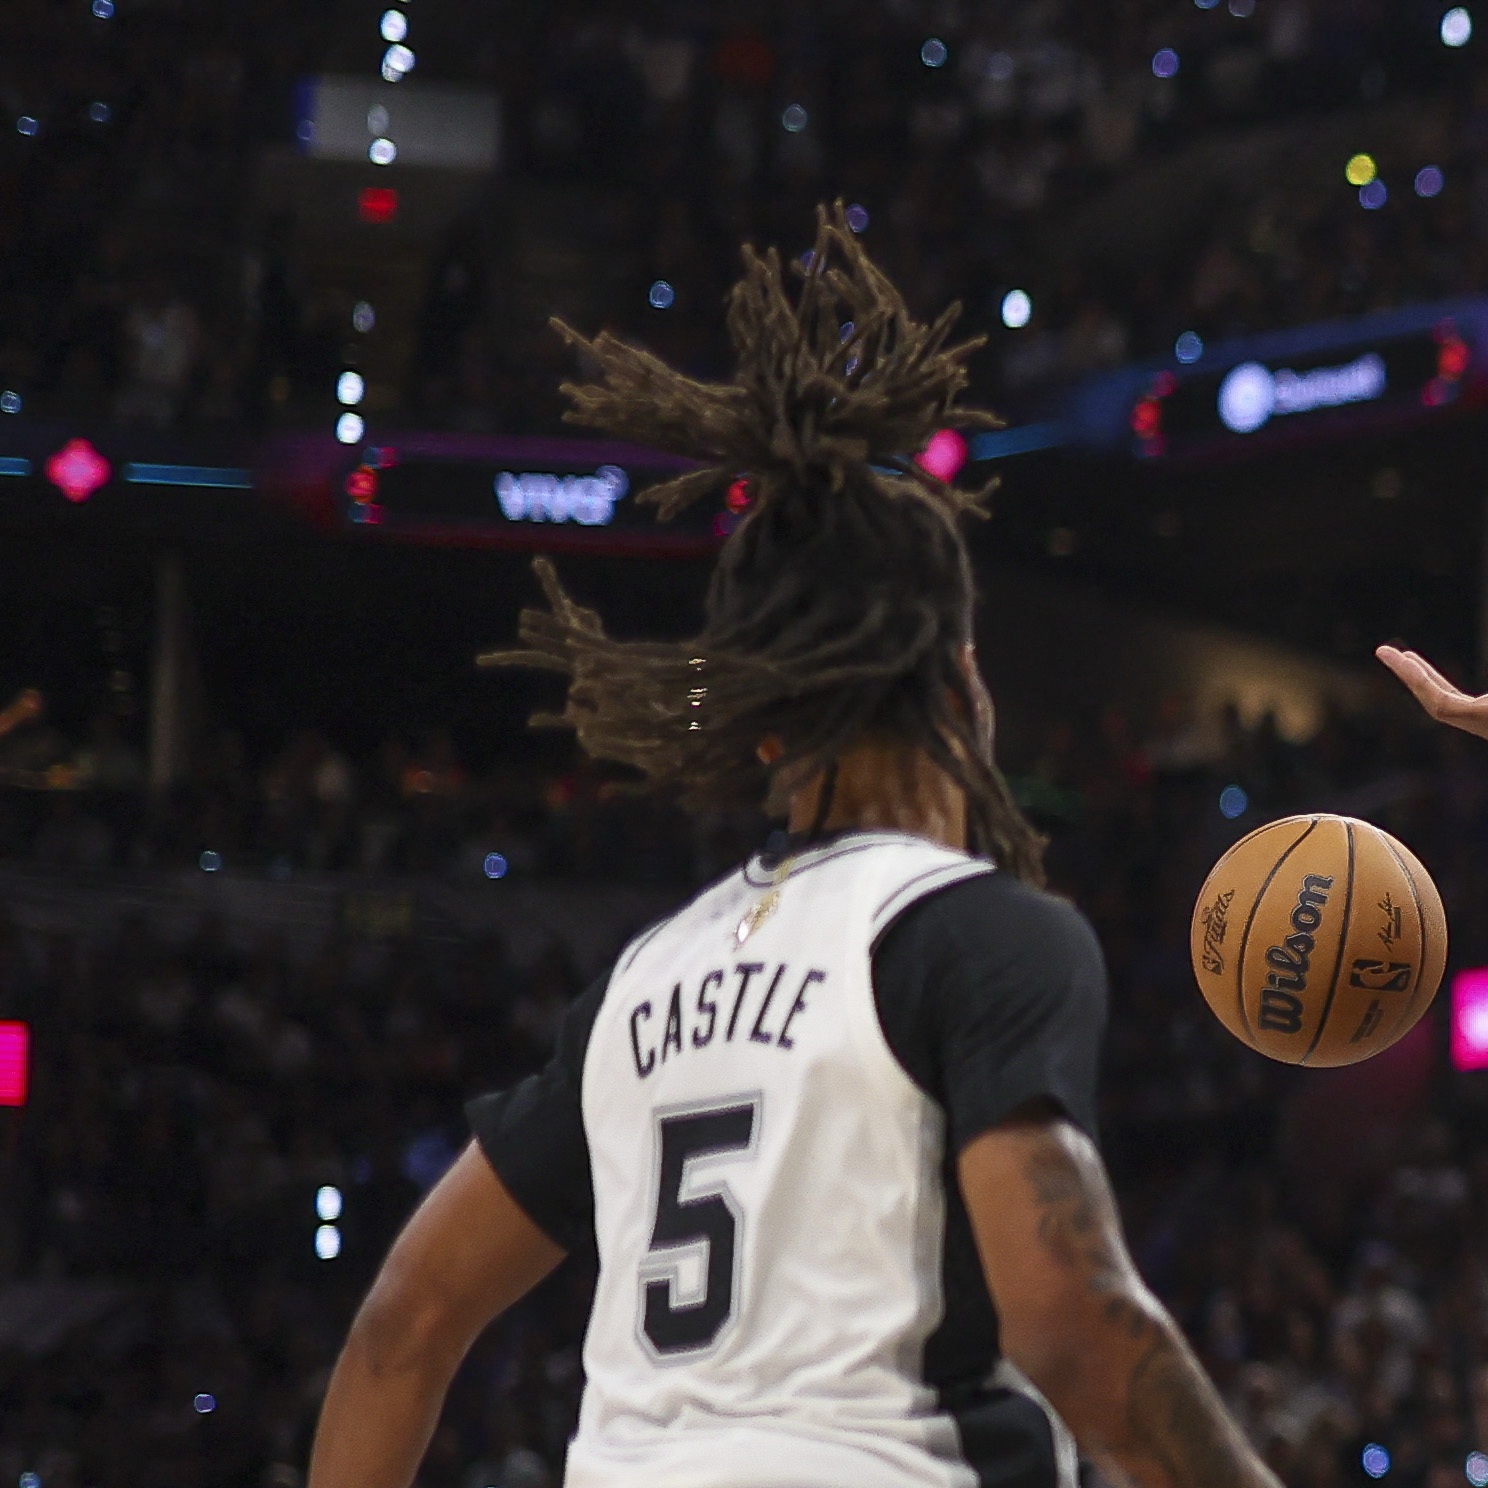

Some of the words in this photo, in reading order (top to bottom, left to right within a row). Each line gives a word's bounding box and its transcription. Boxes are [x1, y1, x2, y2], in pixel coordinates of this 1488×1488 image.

[628, 962, 827, 1080] CASTLE
[1257, 872, 1334, 1036] Wilson
[637, 1092, 763, 1366] 5
